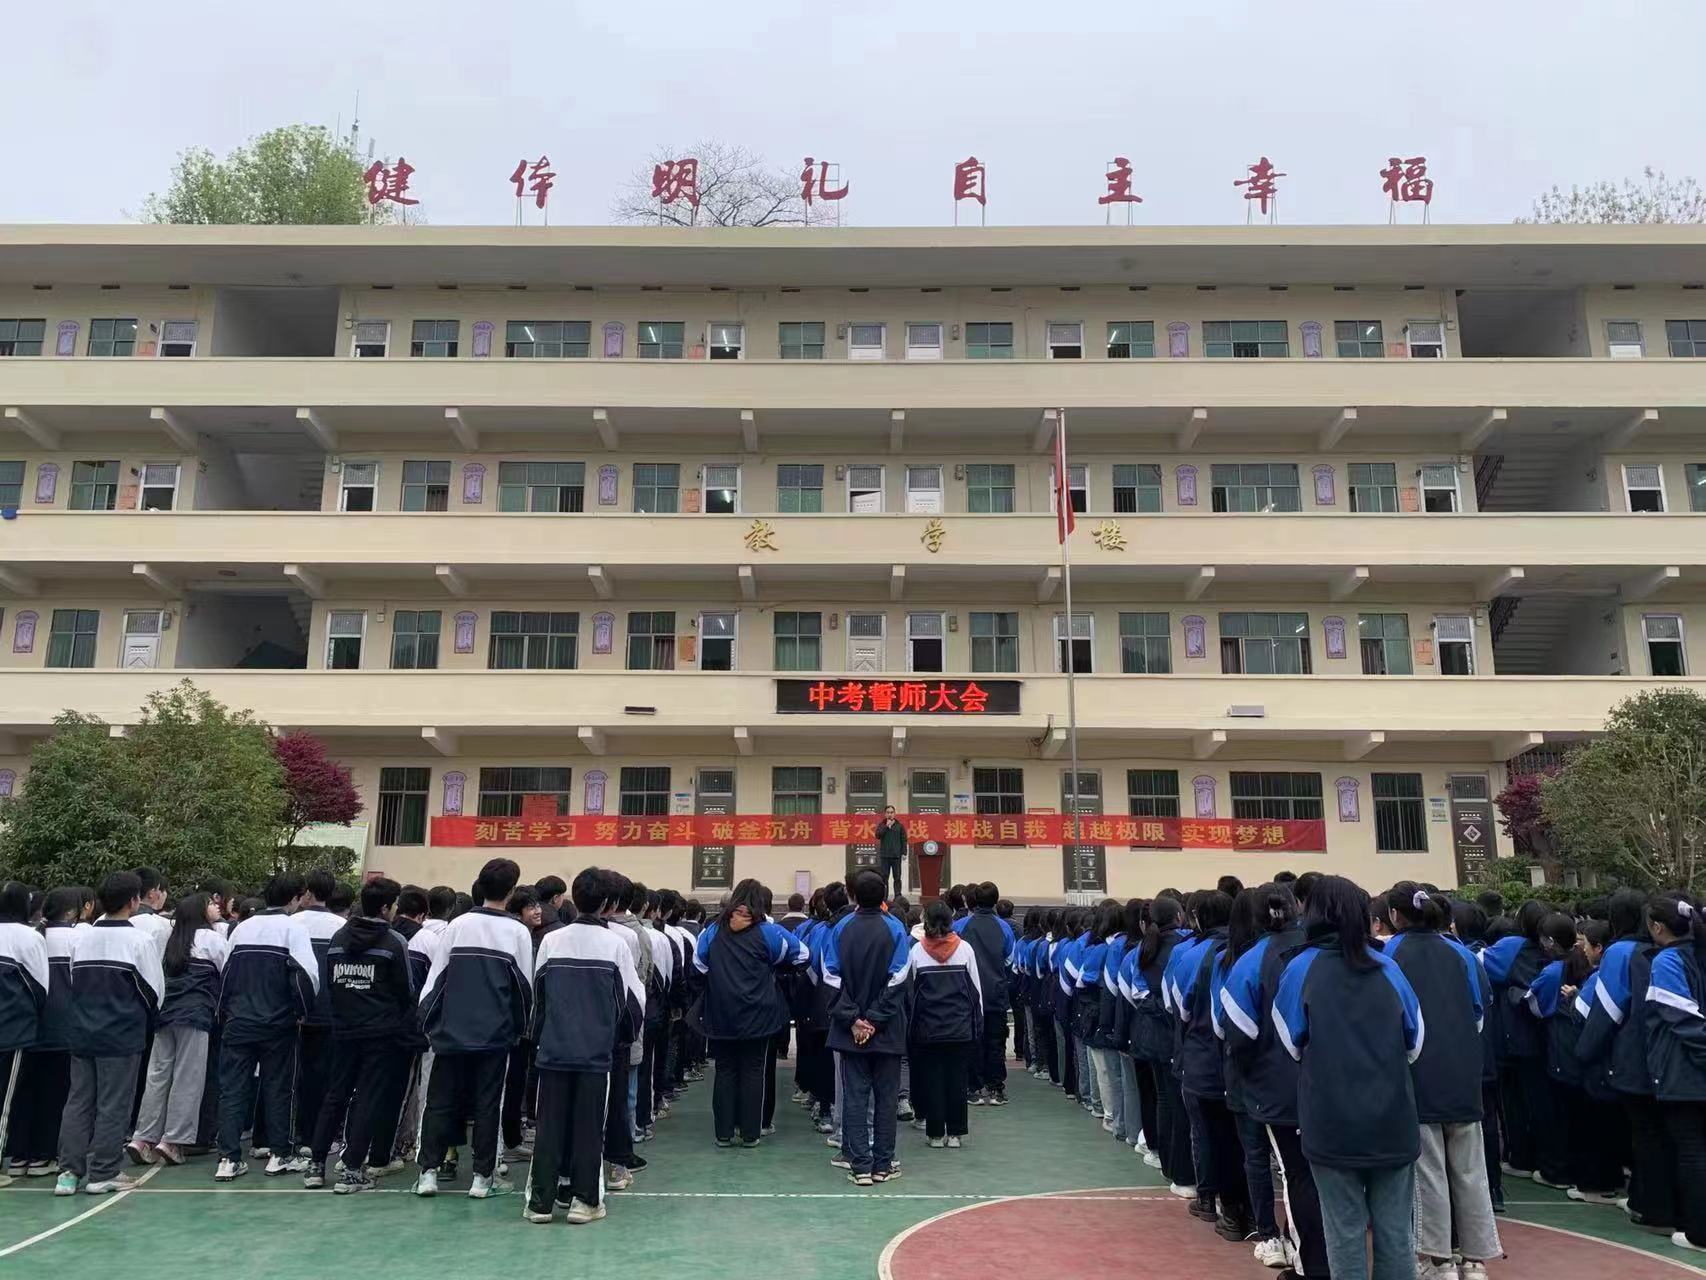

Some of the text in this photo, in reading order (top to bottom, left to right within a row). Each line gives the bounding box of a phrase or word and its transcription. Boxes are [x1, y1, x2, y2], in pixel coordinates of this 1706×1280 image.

[744, 519, 1128, 553] 教学楼
[808, 681, 988, 712] 中考誓师大会
[475, 820, 1286, 845] 刻苦学习 努力奋斗 破釜沉舟 背水战 挑战自我 超越极限 实现梦想
